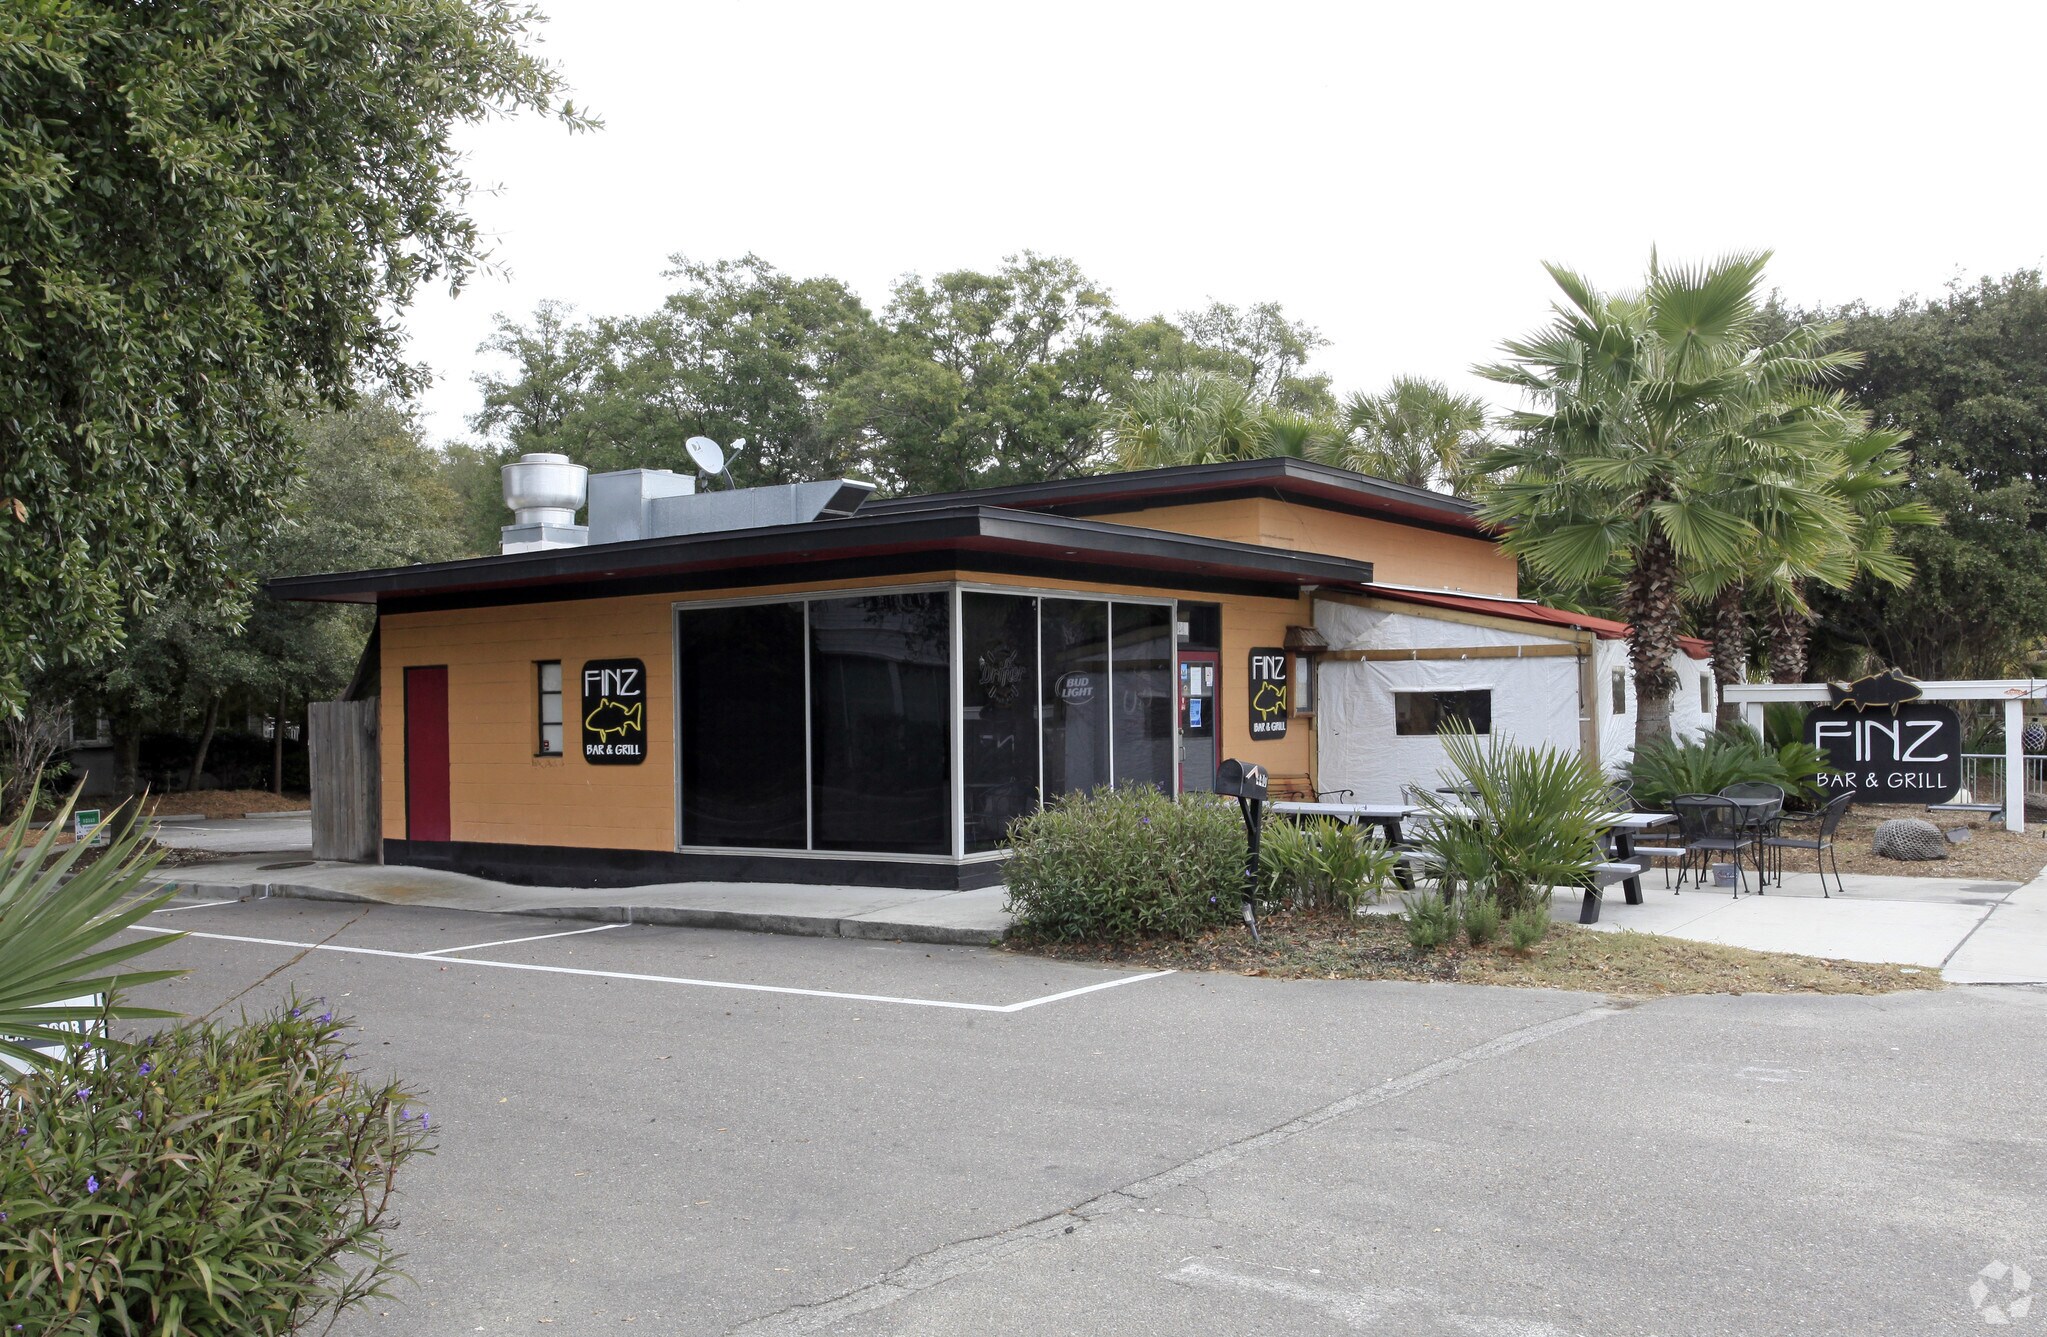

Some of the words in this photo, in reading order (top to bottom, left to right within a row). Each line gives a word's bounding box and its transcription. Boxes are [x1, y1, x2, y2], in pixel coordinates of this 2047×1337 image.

[1252, 656, 1286, 680] FINZ
[585, 668, 641, 697] FINZ
[1066, 677, 1089, 688] BUD
[1061, 687, 1093, 698] LIGHT
[1253, 722, 1265, 732] BAR
[1265, 722, 1271, 731] &
[1271, 721, 1286, 731] GRILL
[1816, 720, 1948, 762] FINZ
[586, 744, 605, 755] BAR
[606, 744, 614, 755] &
[615, 744, 641, 755] GRILL
[1817, 772, 1857, 788] BAR
[1865, 772, 1879, 788] &
[1887, 772, 1947, 789] GRILL
